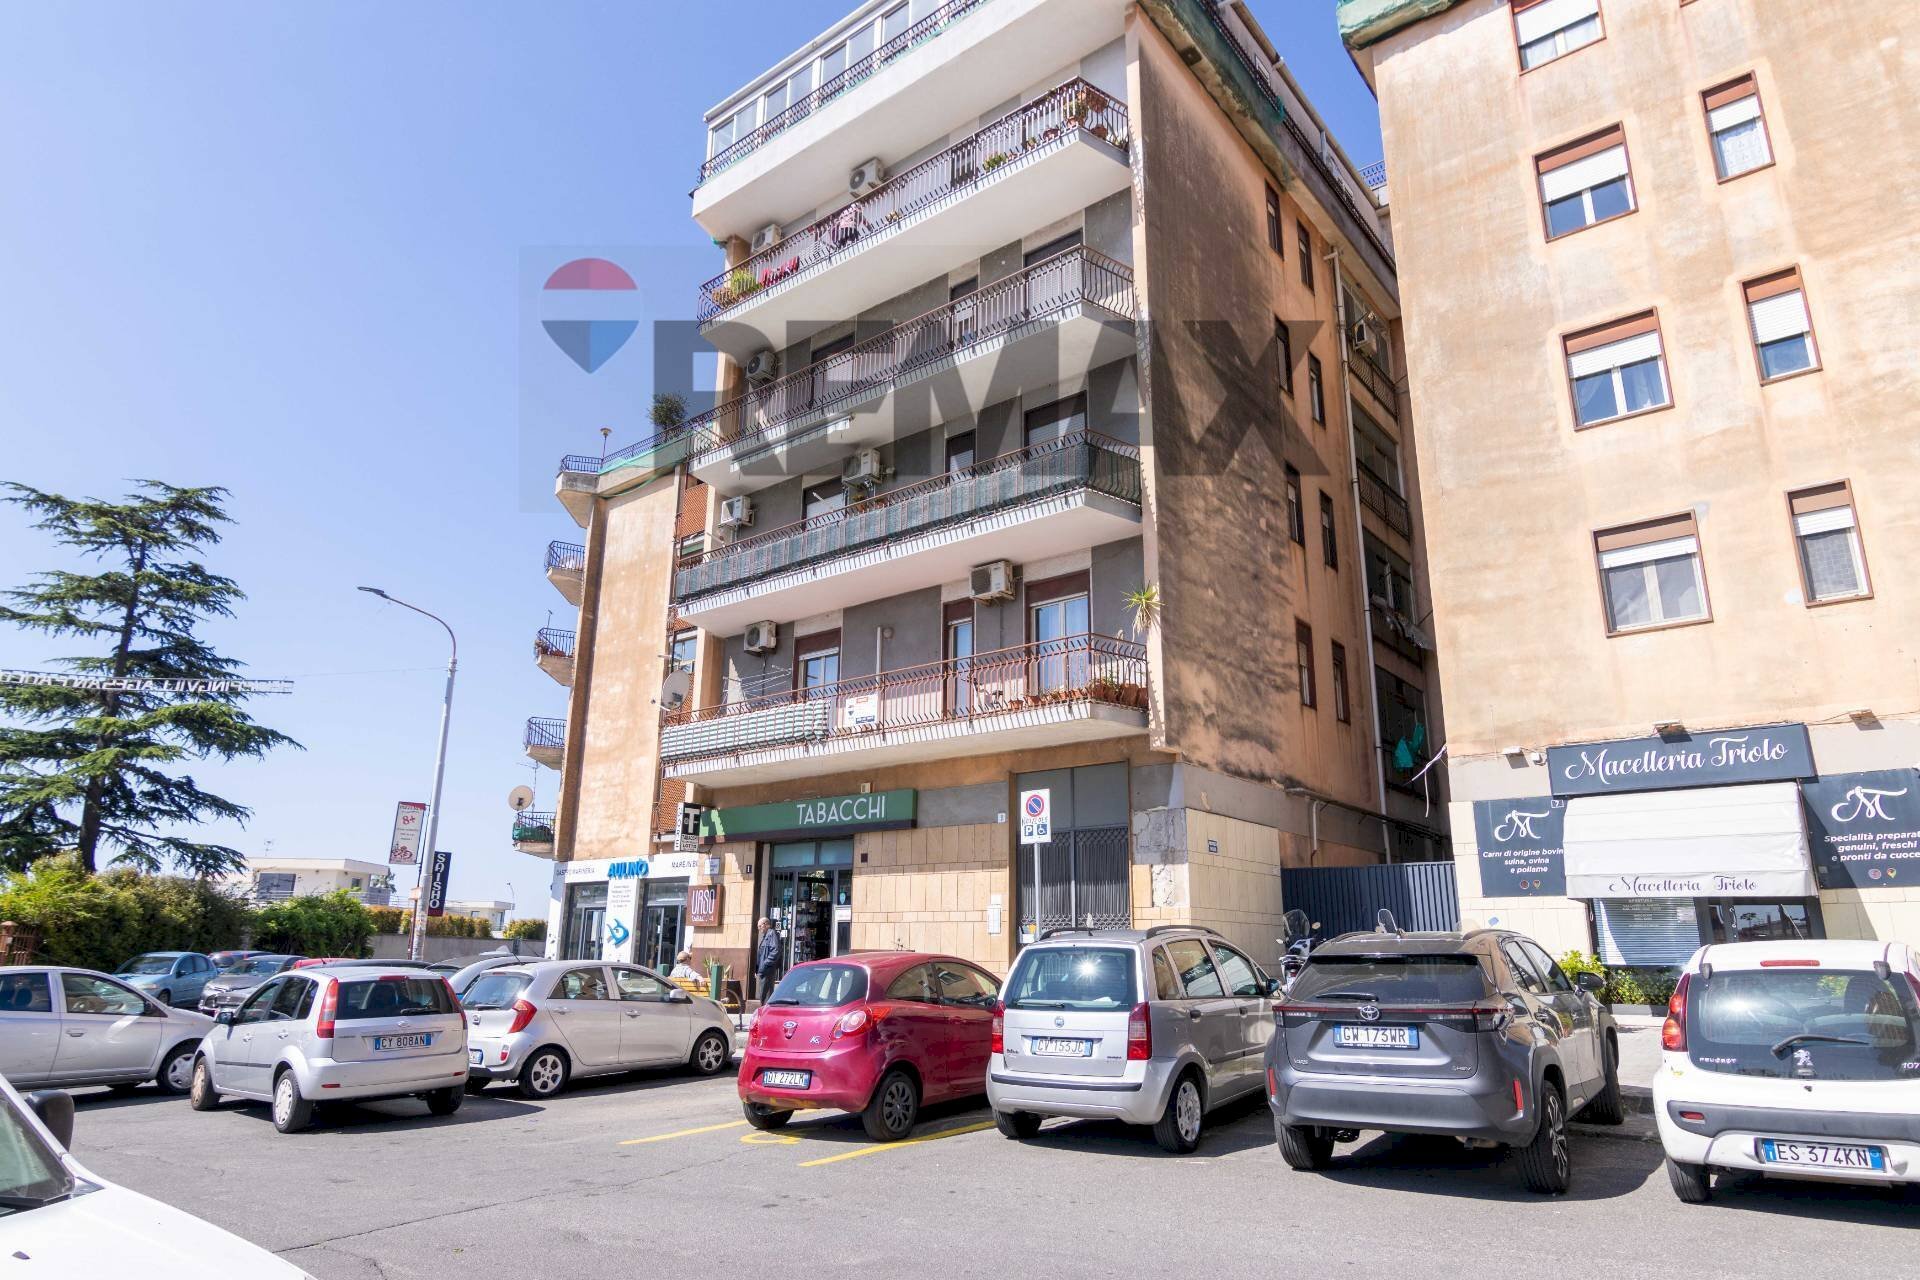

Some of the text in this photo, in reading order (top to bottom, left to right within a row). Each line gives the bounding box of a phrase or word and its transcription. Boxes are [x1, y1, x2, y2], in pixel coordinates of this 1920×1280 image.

[1565, 736, 1789, 785] Macelleria Triolo
[796, 795, 886, 825] TABACCHI
[1824, 832, 1874, 843] Specialità
[1882, 841, 1917, 849] freschi
[1513, 848, 1540, 858] origine
[1840, 852, 1871, 862] pronti
[1874, 852, 1887, 860] da
[1517, 866, 1548, 874] pollame
[429, 853, 446, 909] SAISHO
[1609, 875, 1757, 896] Macelleria Triolo
[691, 889, 715, 914] URSO
[396, 1035, 425, 1047] 808AN
[1343, 1026, 1406, 1043] GW 173WR
[1902, 1062, 1920, 1070] 107
[1776, 1143, 1800, 1161] ES
[1808, 1145, 1869, 1167] 374KN
